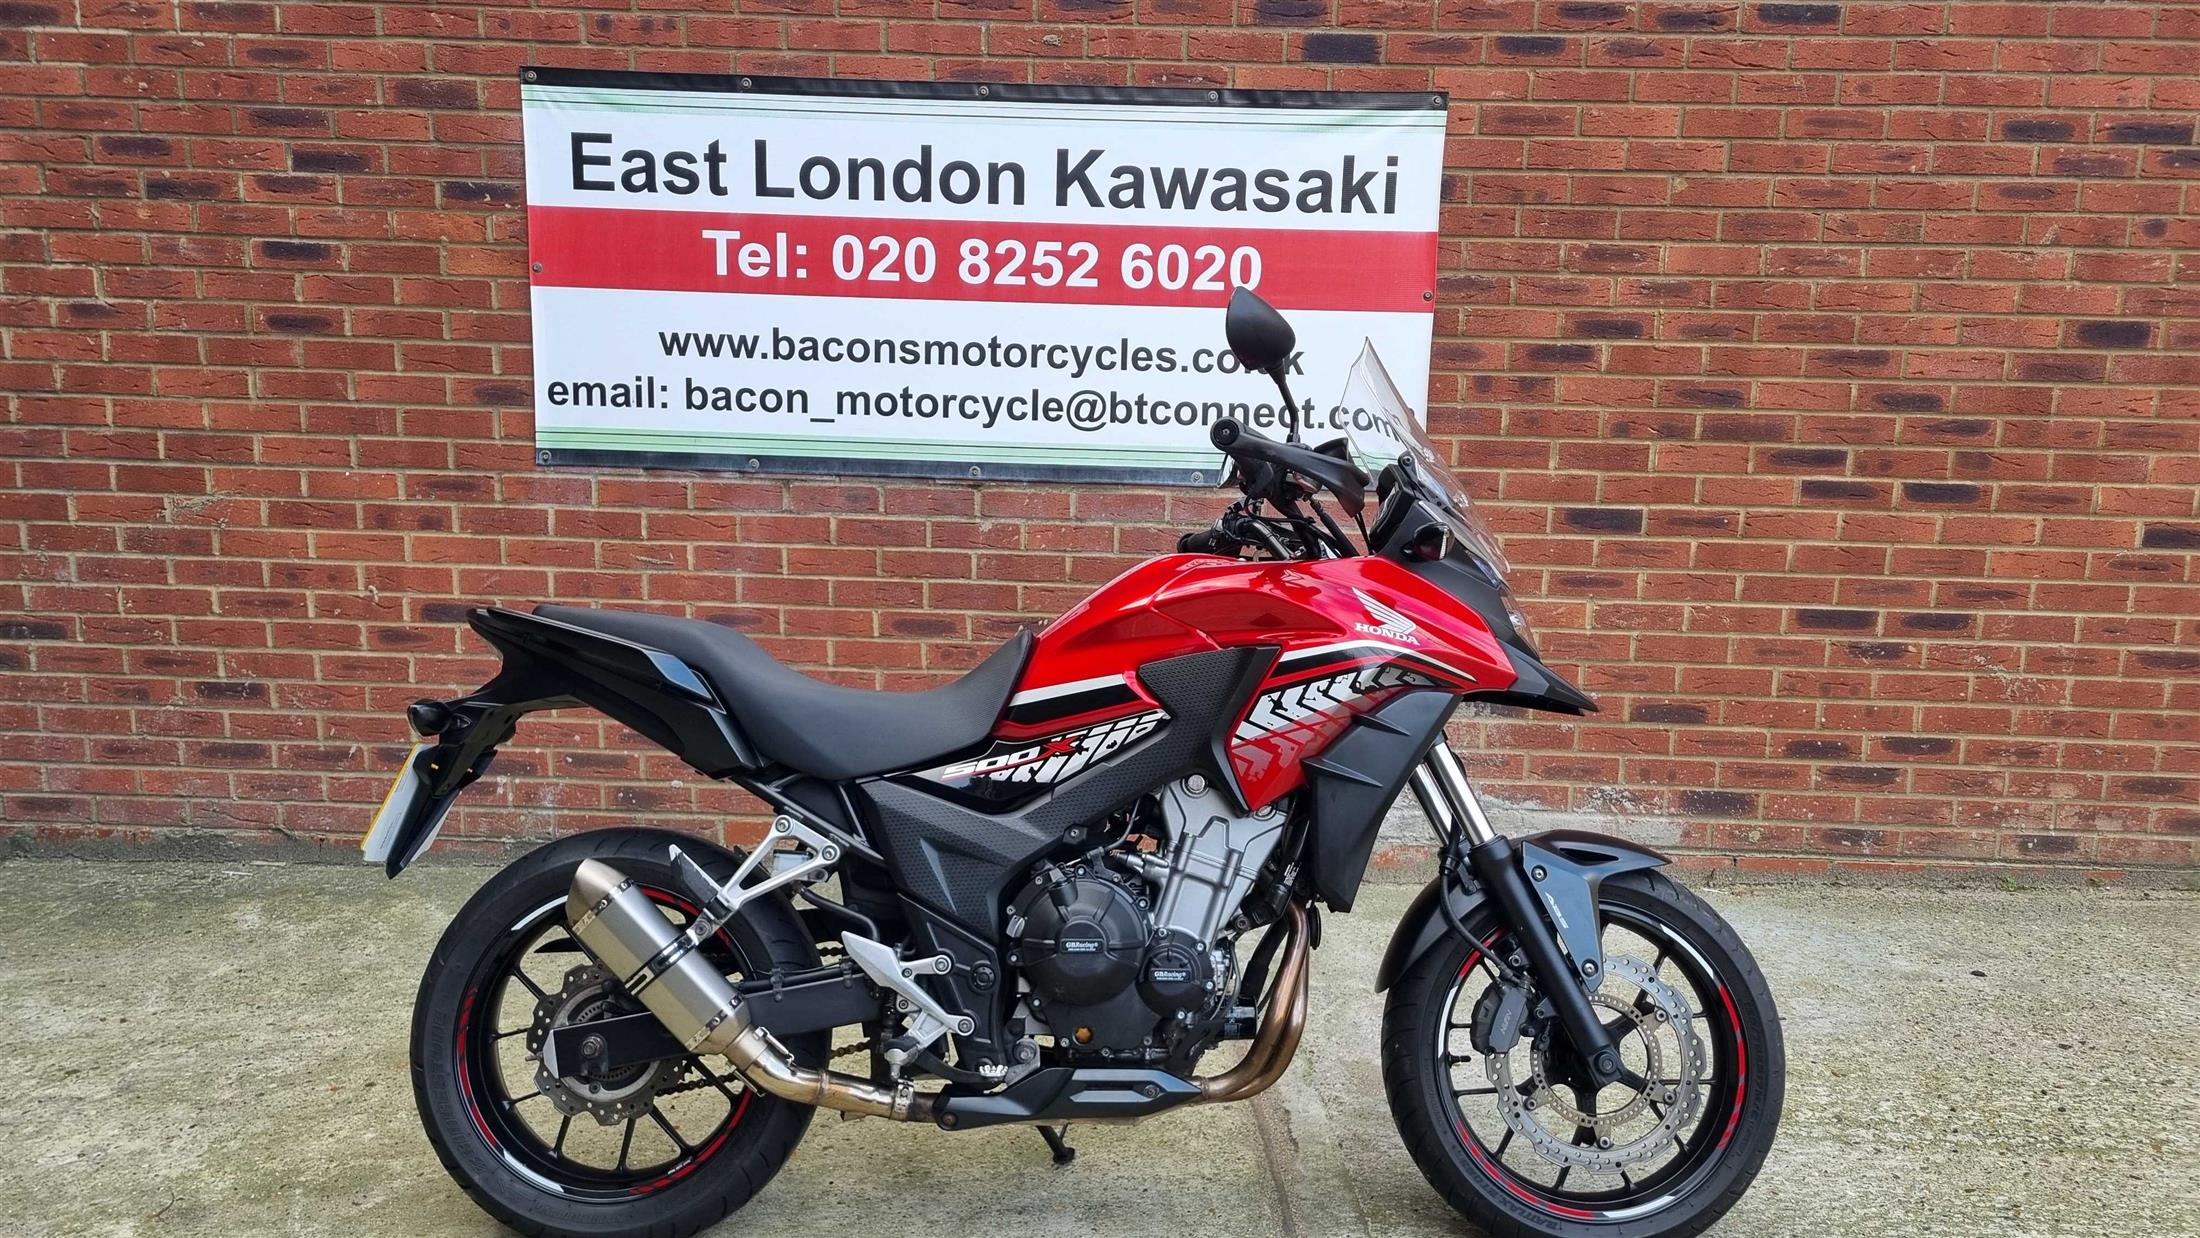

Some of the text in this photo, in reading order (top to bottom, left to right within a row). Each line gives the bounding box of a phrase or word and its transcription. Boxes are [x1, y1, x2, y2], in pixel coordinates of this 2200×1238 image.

[571, 131, 1399, 214] East London Kawasaki
[702, 230, 1262, 290] Tel: 020 8252 6020
[659, 327, 1304, 378] www.baconsmotorcycles.co.k
[547, 376, 1402, 441] email: bacon_motorcycle@btconnect.com
[1354, 622, 1421, 646] HONDA
[942, 735, 1081, 780] 500X
